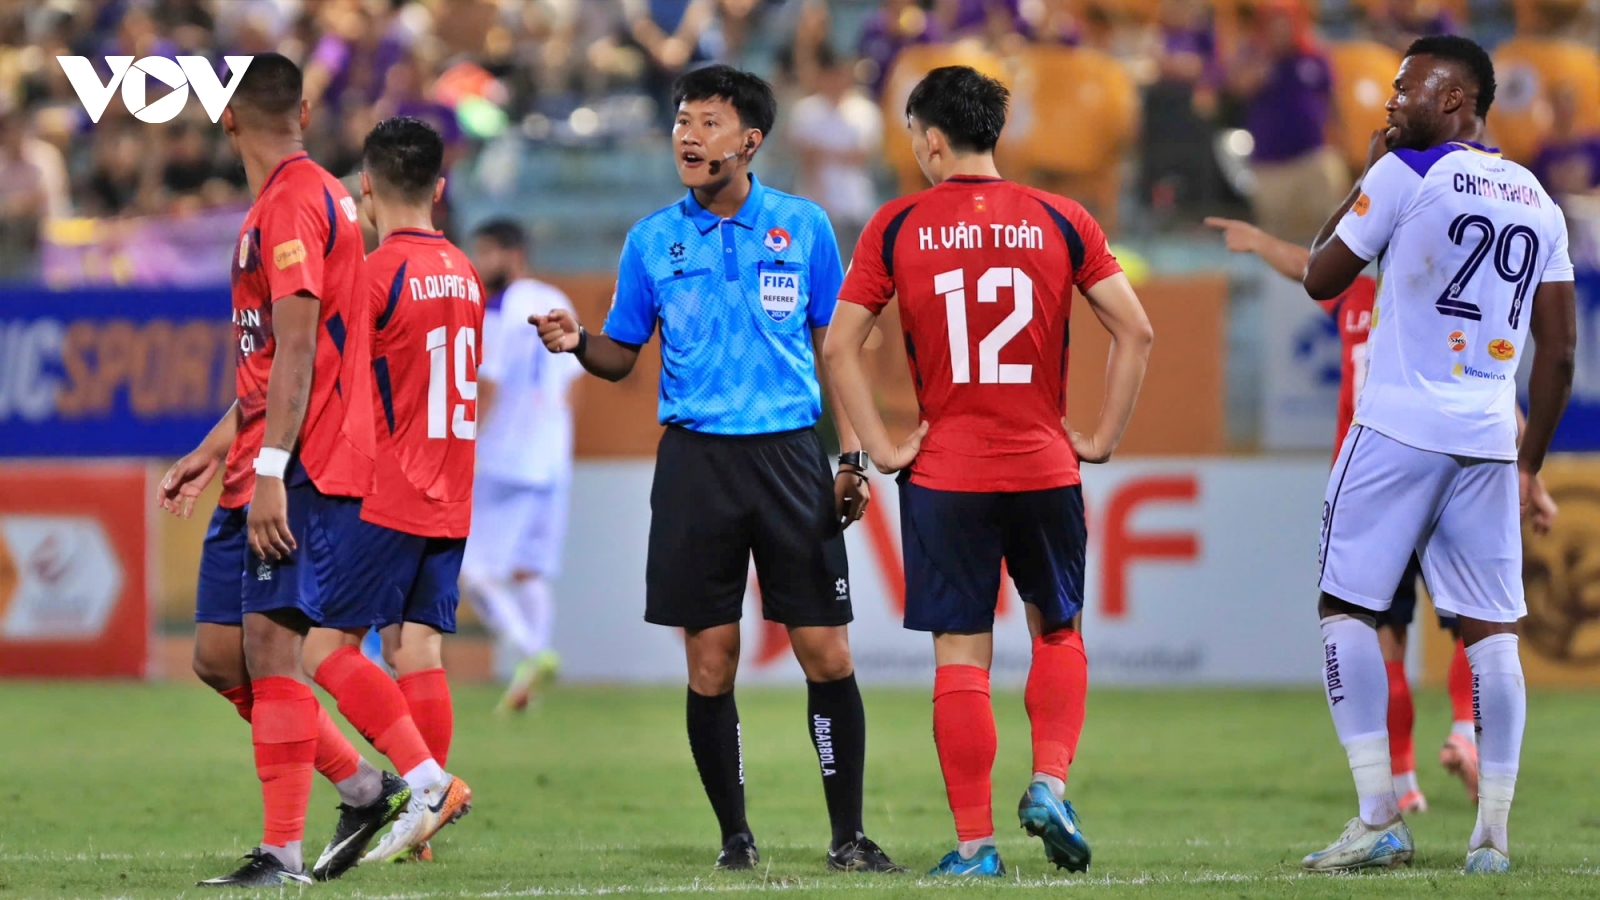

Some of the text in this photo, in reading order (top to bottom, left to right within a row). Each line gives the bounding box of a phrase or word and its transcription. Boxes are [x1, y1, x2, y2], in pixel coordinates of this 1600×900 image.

[918, 220, 1043, 250] H.VĂN TOẢN
[763, 275, 795, 289] FIFA
[763, 294, 795, 304] REFEREE
[1435, 213, 1539, 330] 29
[934, 267, 1034, 384] 12
[426, 325, 477, 440] 19
[813, 714, 837, 777] JOGARBOLA
